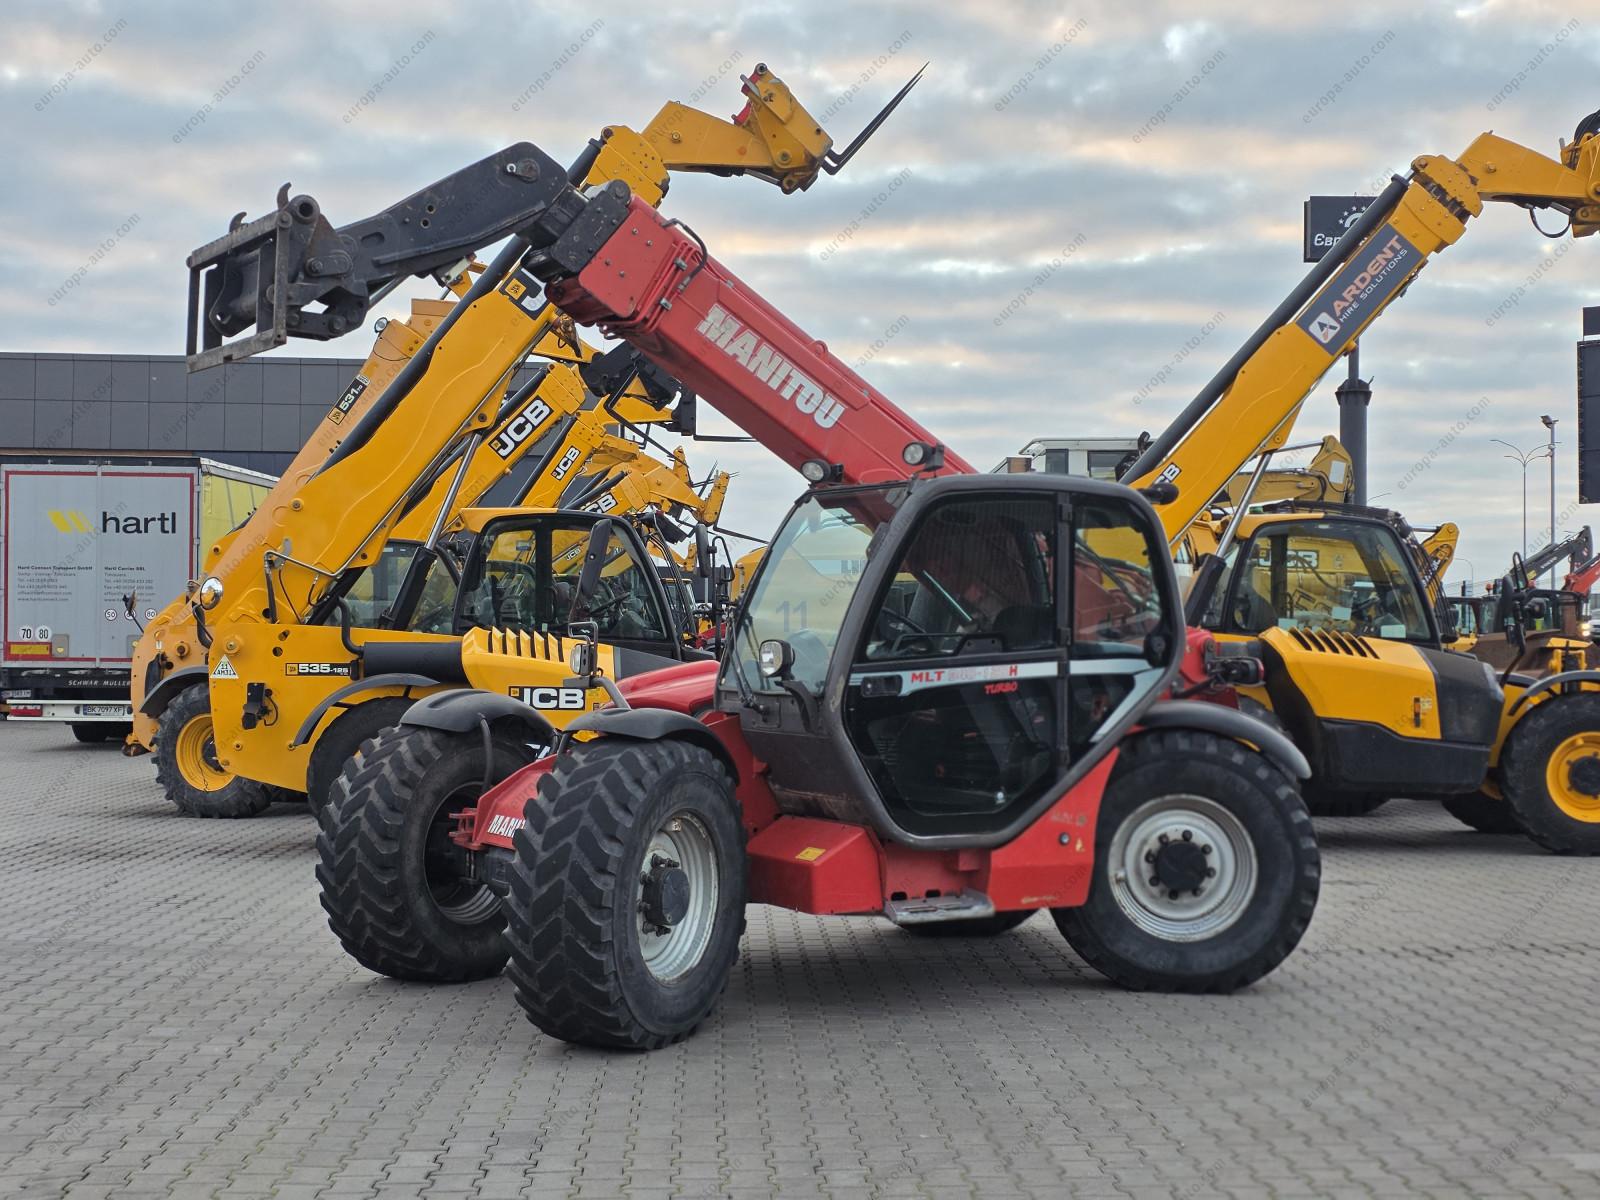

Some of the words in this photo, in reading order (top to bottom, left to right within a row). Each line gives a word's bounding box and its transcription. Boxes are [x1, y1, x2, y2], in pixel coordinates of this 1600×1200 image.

[1333, 234, 1402, 317] ARDENT
[1339, 300, 1360, 322] HIRE
[1359, 248, 1408, 300] SOLUTIONS
[695, 303, 848, 429] MANITOU
[498, 399, 551, 457] JCB
[555, 447, 580, 480] JCB
[102, 511, 177, 534] hartl
[21, 628, 32, 639] 70
[38, 628, 49, 639] 80
[911, 671, 945, 683] MLT
[1008, 664, 1018, 676] H
[523, 687, 585, 710] JCB
[984, 681, 1018, 695] TURBO
